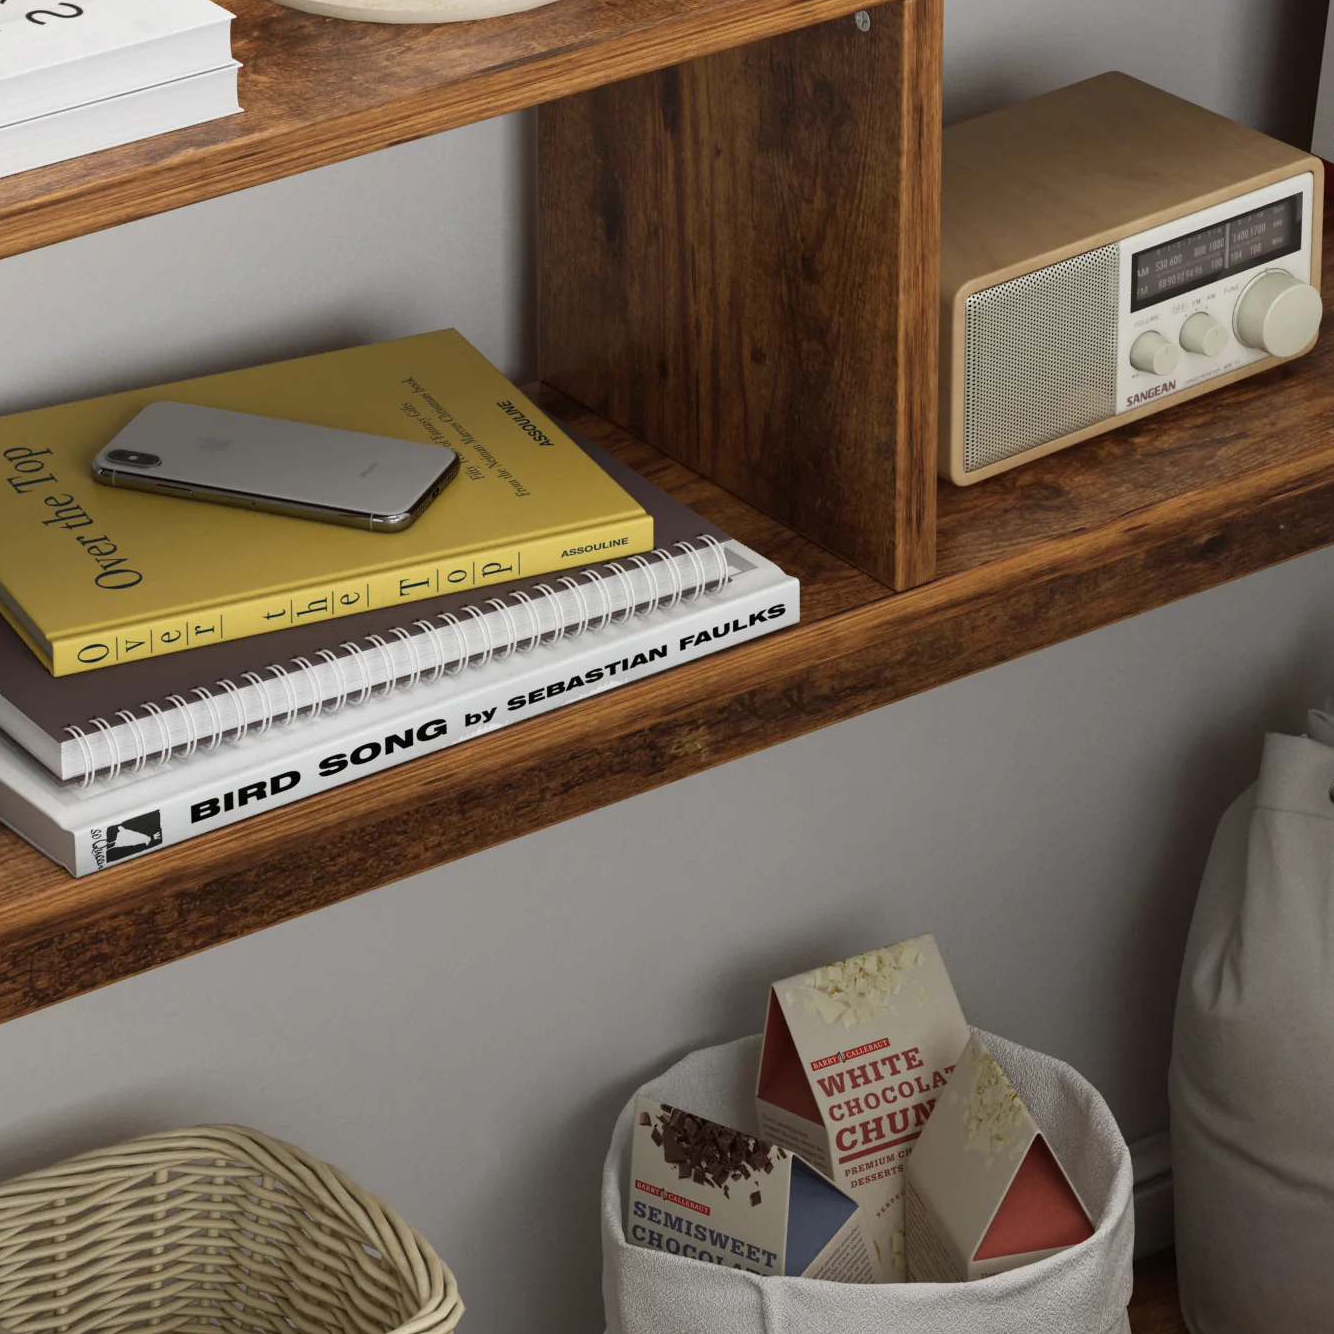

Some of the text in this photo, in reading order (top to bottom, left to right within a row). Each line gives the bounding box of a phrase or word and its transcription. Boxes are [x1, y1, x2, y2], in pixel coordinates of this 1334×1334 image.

[1170, 253, 1182, 266] 600
[1209, 238, 1224, 251] 1000
[1250, 222, 1266, 236] 1700
[1211, 257, 1223, 270] 100
[1230, 250, 1242, 263] 104
[402, 377, 424, 393] book
[1127, 380, 1176, 407] SANGEAN
[421, 393, 453, 423] Christmas
[497, 400, 555, 446] ASSOULINE
[451, 422, 473, 445] Marcus
[497, 468, 510, 479] the
[509, 478, 530, 497] From
[3, 447, 143, 589] Over the Top
[77, 537, 629, 664] Over the Top ASSOULINE
[190, 604, 787, 824] BIRD SONG by SEBASTIAN FAULKS
[812, 1040, 888, 1070] BARRY CALLEBAUT
[816, 1047, 924, 1097] WHITE
[845, 1153, 895, 1177] PREMIUM
[851, 1164, 904, 1188] DESSERTS
[637, 1181, 710, 1214] BARRY CALLEBAUT
[633, 1201, 777, 1268] SEMISWEET
